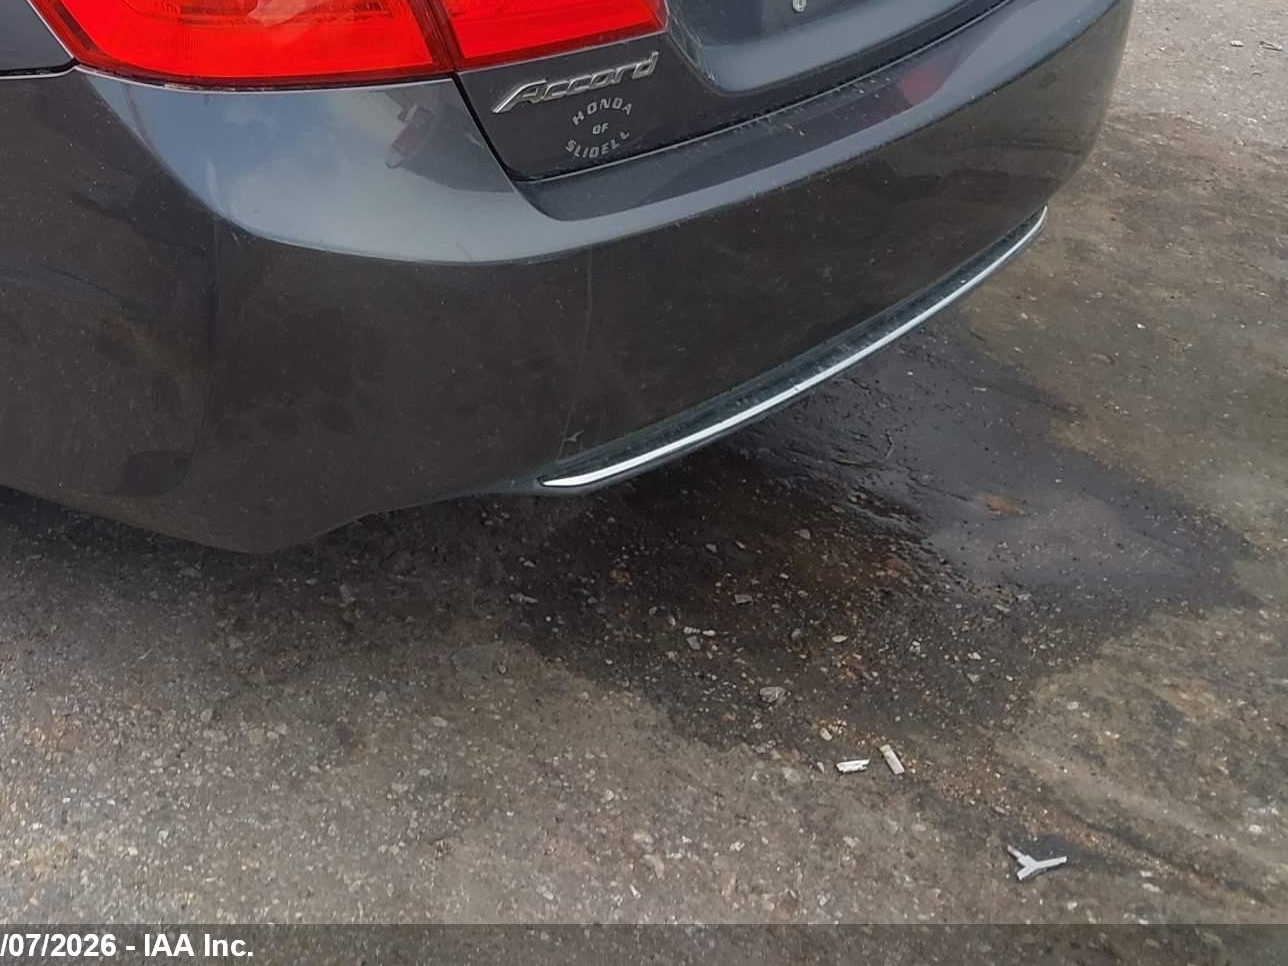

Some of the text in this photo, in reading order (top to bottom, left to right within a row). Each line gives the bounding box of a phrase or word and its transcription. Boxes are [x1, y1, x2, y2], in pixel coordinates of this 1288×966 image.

[492, 50, 659, 114] Accord
[572, 97, 632, 126] HONDA
[592, 122, 609, 135] OF
[565, 131, 630, 158] SLIDELL
